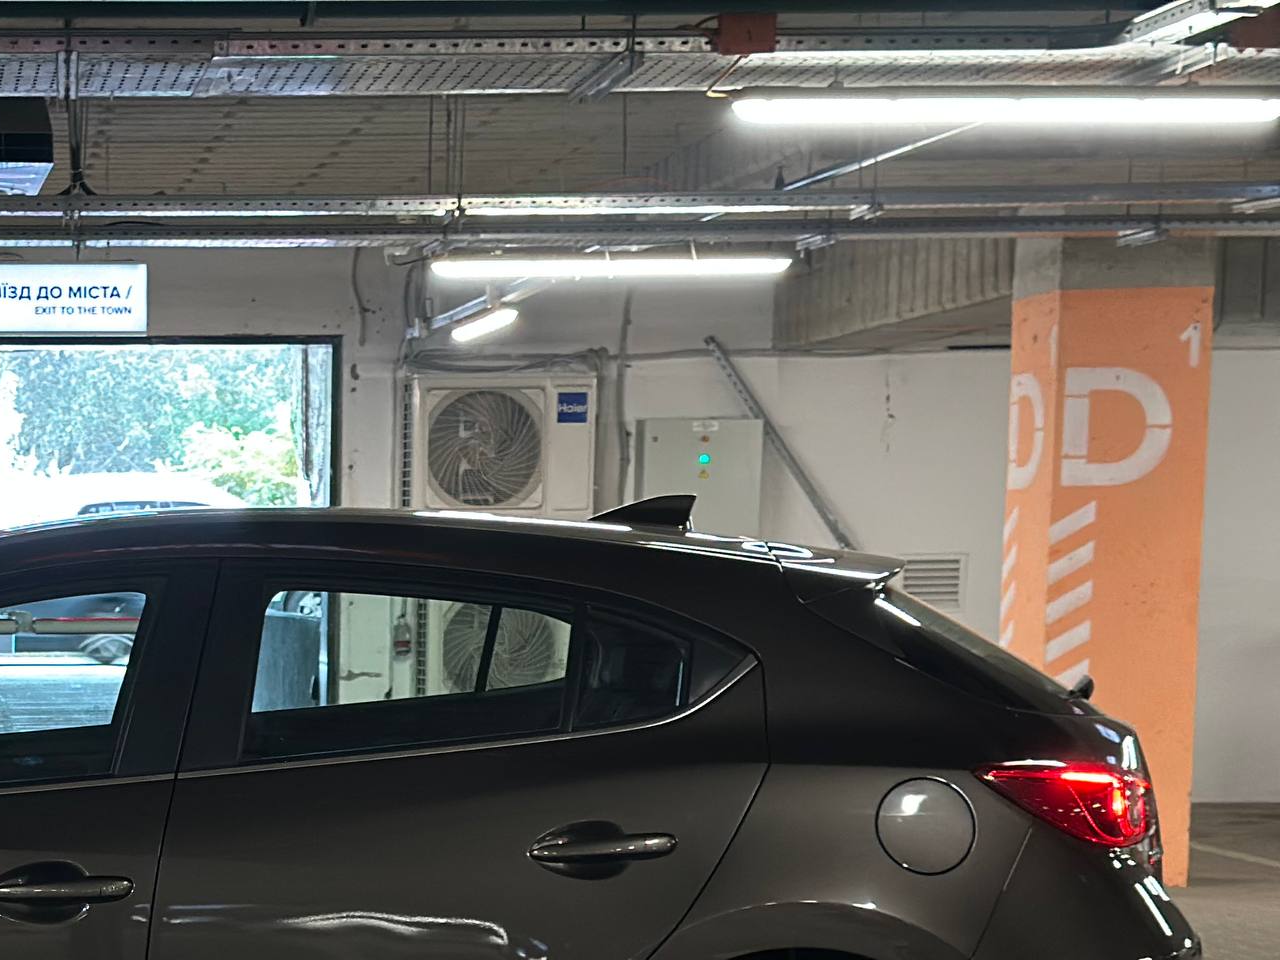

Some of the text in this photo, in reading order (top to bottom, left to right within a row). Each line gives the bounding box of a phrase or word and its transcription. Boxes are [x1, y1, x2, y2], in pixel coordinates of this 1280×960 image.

[37, 286, 62, 300] ДО
[68, 286, 121, 299] МІСТА
[34, 306, 132, 315] EXIT TO THE TOWN
[1179, 323, 1201, 368] 1
[558, 403, 588, 413] Haier
[1006, 373, 1045, 490] D
[1061, 367, 1173, 487] D
